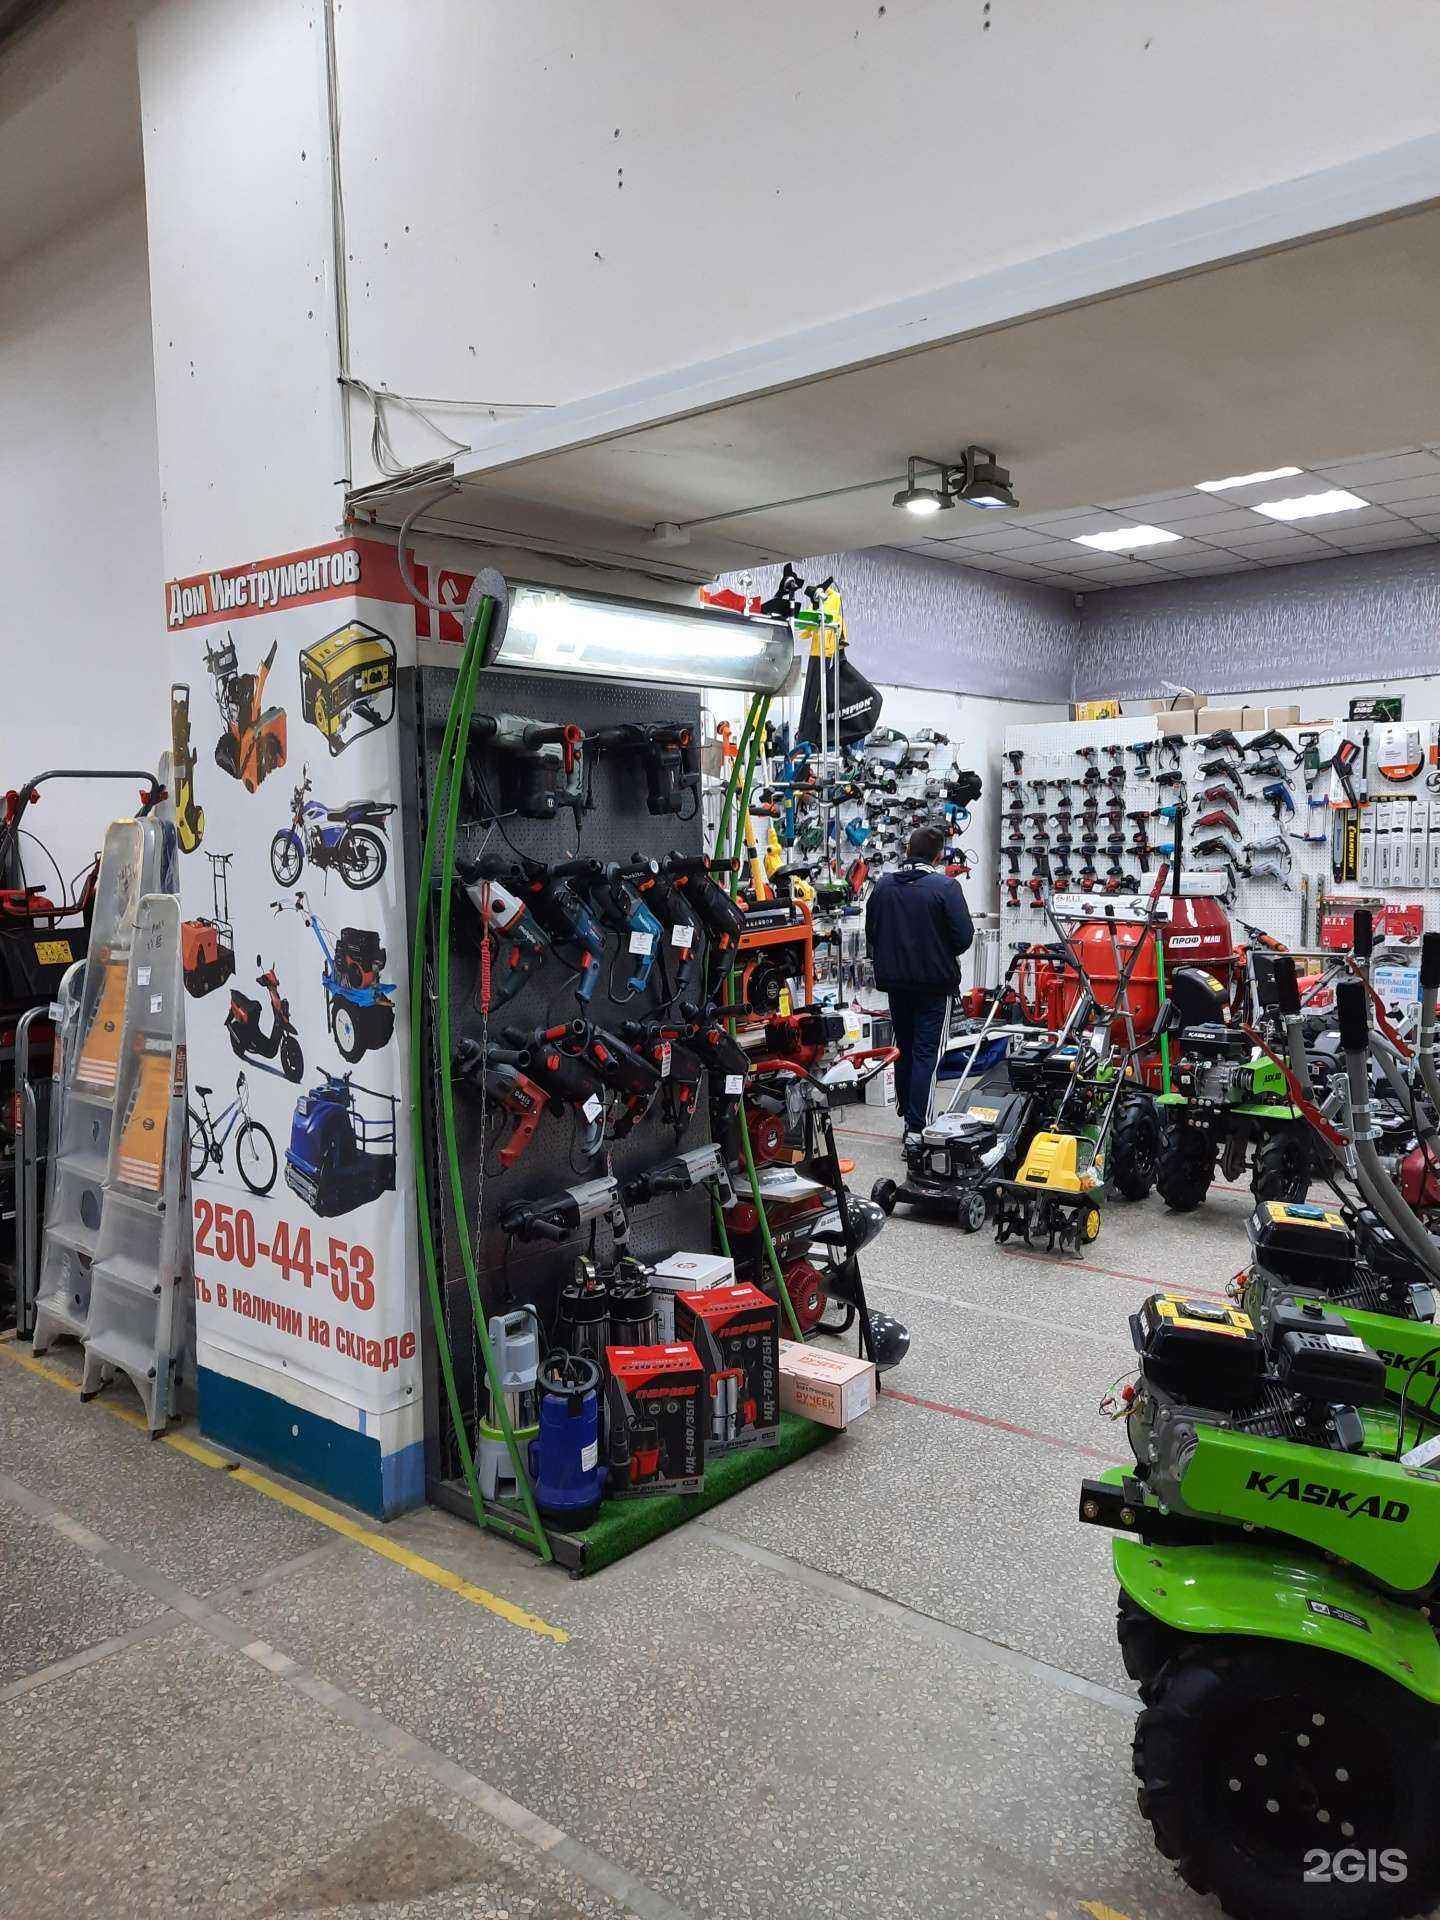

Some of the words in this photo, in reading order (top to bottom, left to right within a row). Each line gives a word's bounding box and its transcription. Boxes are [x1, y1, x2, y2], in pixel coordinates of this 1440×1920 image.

[169, 583, 208, 627] Дом
[209, 549, 361, 612] Инструментов
[1172, 936, 1200, 946] ПРОФ
[1323, 917, 1348, 926] P.I.T.
[193, 1198, 376, 1312] 250-44-53
[217, 1285, 228, 1308] в
[232, 1288, 303, 1338] наличии
[308, 1314, 331, 1348] на
[336, 1326, 417, 1373] складе
[1245, 1470, 1412, 1524] KASKAD
